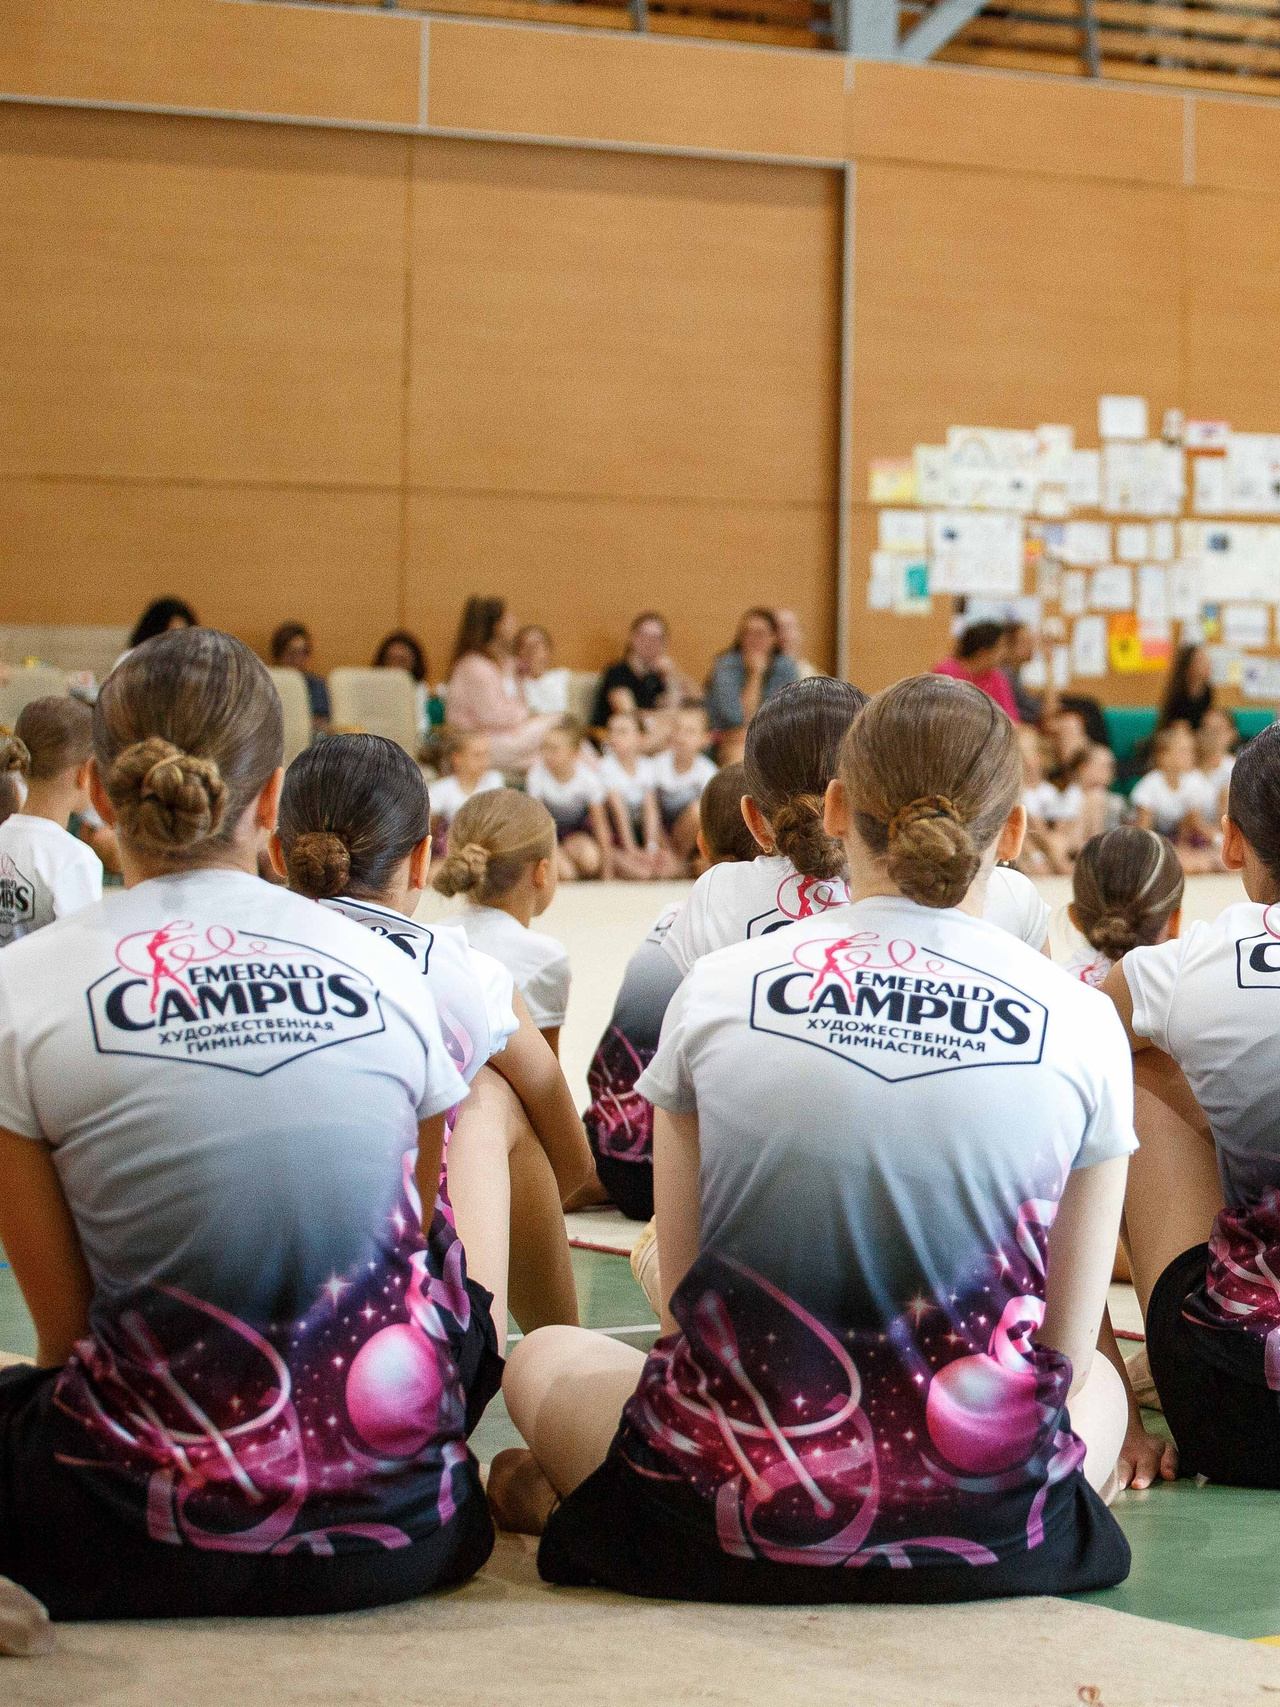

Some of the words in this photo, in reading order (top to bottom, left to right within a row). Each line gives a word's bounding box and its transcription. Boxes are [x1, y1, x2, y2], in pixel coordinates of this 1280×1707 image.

[188, 962, 324, 985] EMERALD
[855, 971, 994, 1002] EMERALD
[105, 974, 369, 1031] CAMPUS
[767, 971, 1031, 1045] CAMPUS
[159, 1017, 334, 1045] ХУДОЖЕСТВЕННАЯ
[186, 1032, 317, 1054] ГИМНАСТИКА
[807, 1018, 986, 1053] ХУДОЖЕСТВЕННАЯ
[829, 1032, 961, 1061] ГИМНАСТИКА
